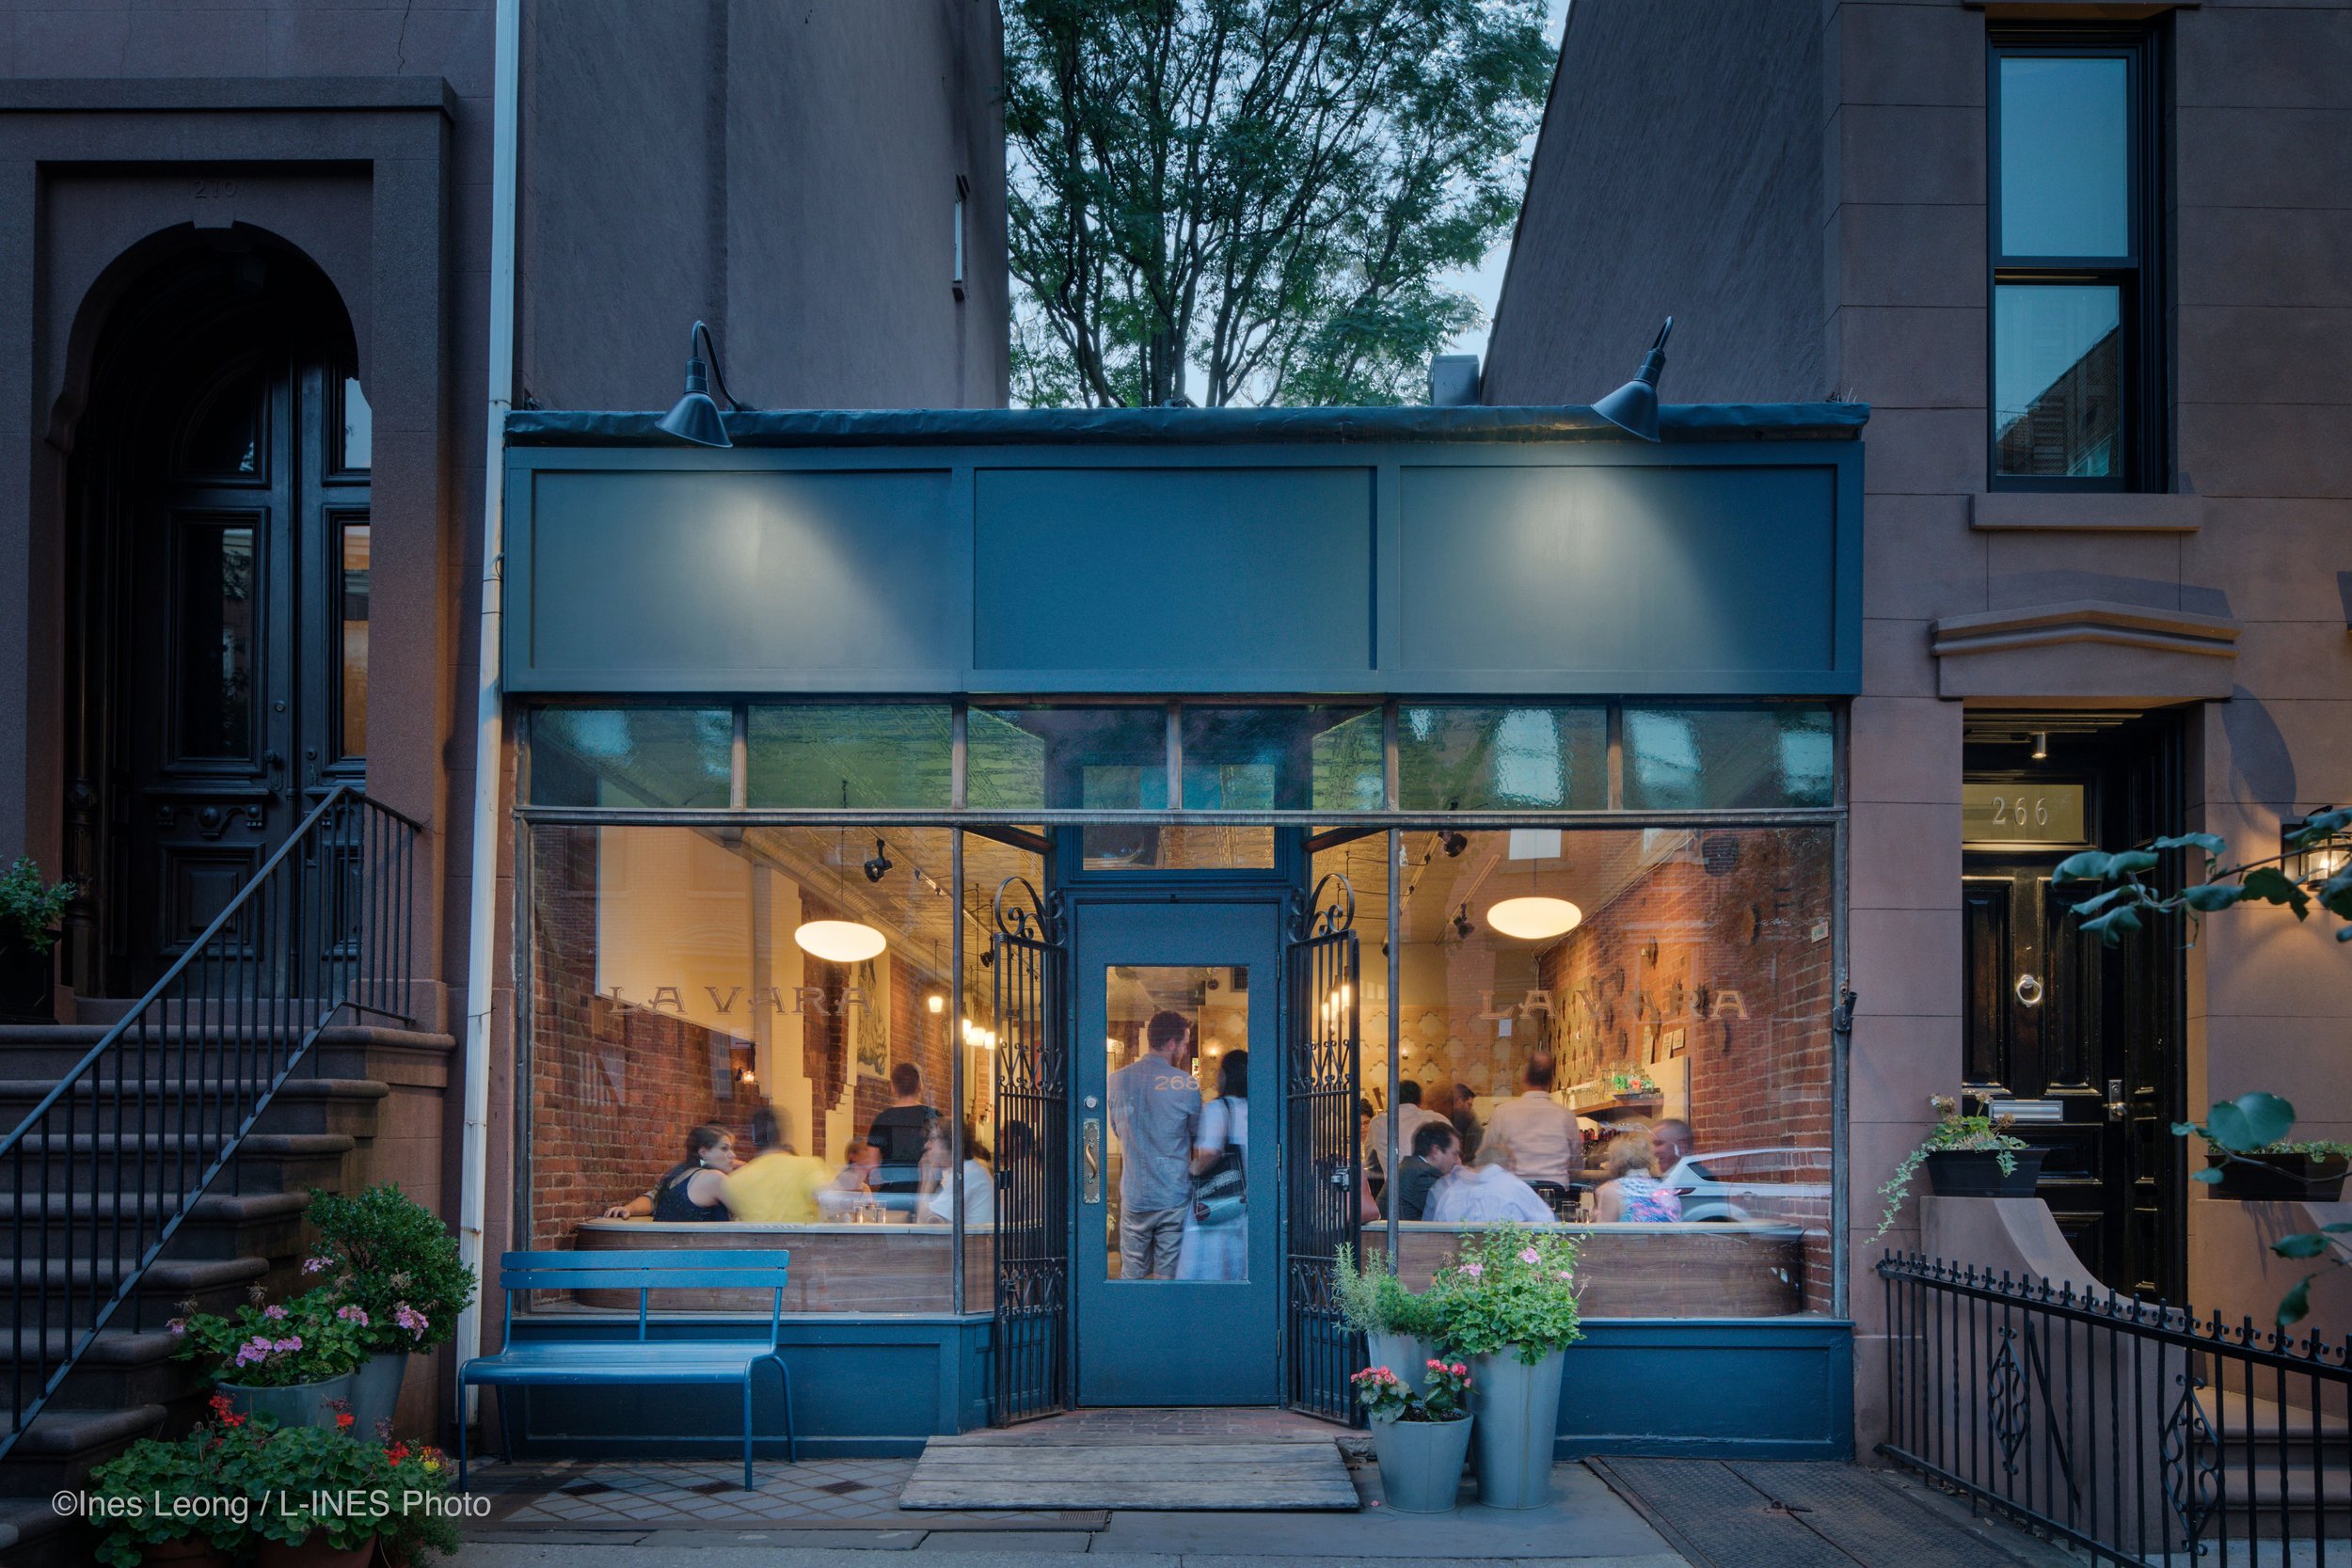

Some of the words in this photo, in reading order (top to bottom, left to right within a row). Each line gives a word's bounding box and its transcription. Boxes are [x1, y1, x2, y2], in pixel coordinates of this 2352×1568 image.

[194, 179, 238, 199] 270
[1991, 796, 2048, 826] 266
[609, 986, 688, 1015] LA
[704, 986, 875, 1016] VARA
[1477, 989, 1557, 1020] LA
[1577, 989, 1751, 1021] VARA
[1154, 1075, 1200, 1090] 268
